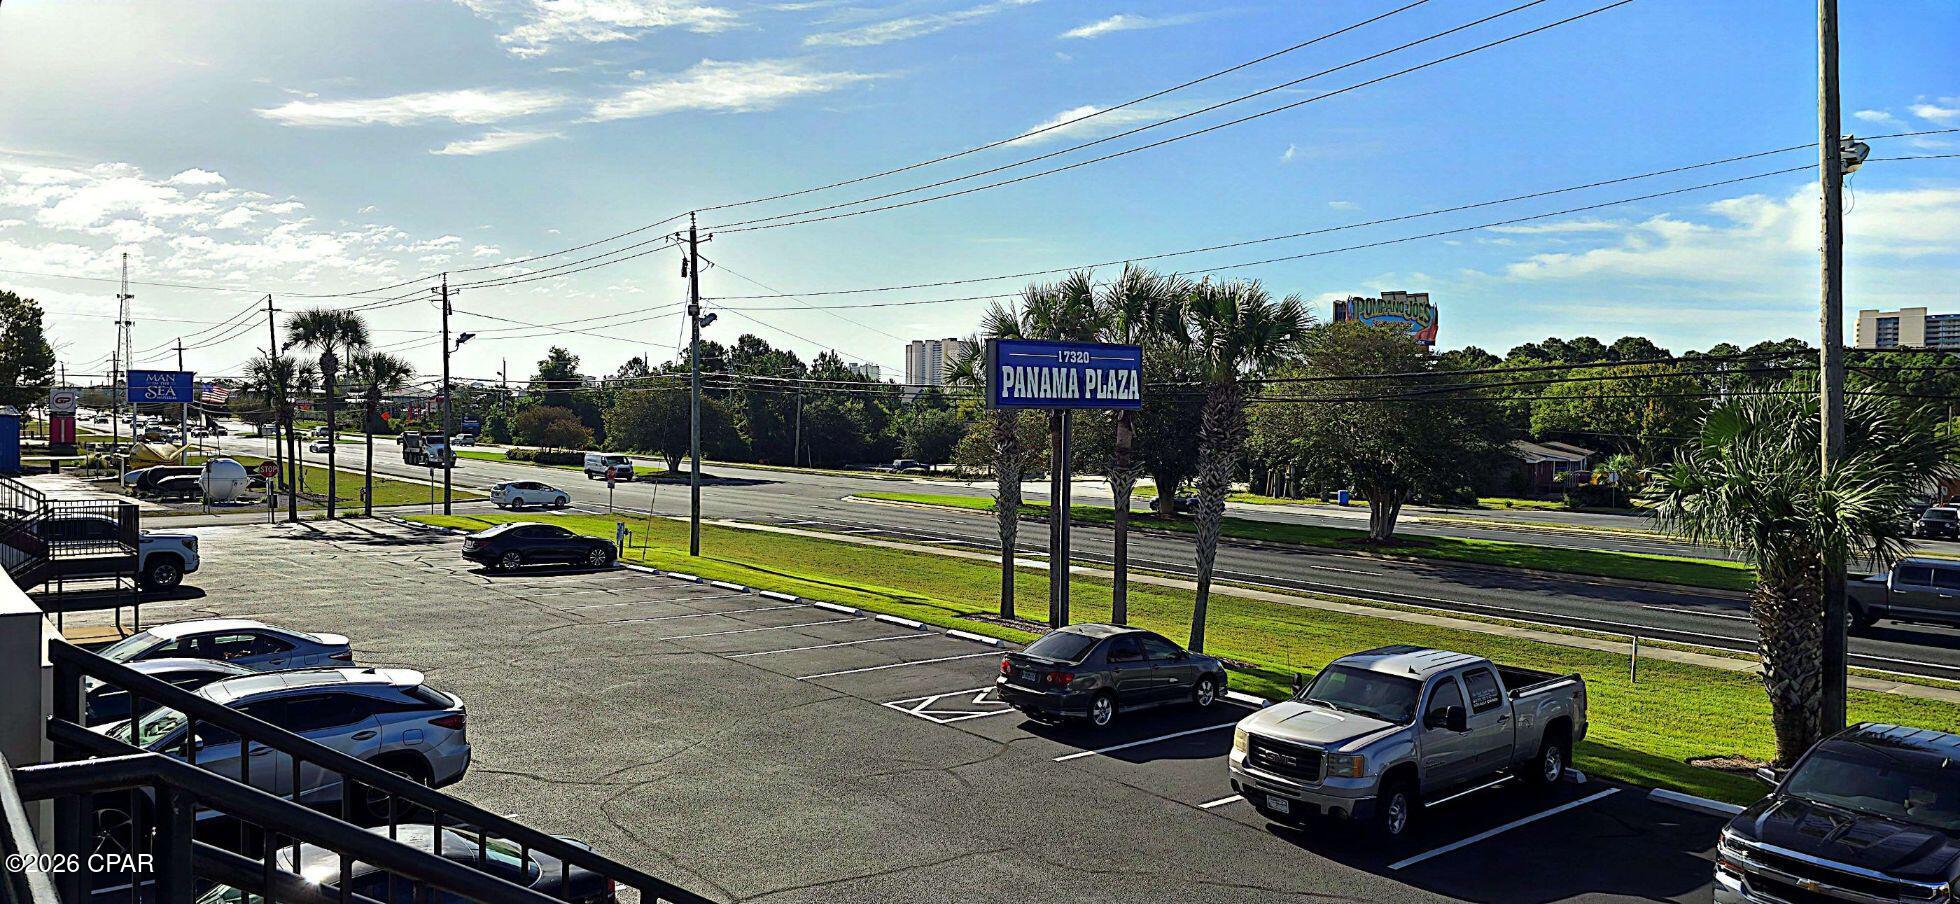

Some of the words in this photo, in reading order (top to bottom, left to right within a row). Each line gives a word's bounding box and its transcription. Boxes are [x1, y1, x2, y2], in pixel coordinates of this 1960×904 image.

[1058, 350, 1090, 364] 17320
[146, 374, 176, 382] MAN
[1002, 365, 1080, 399] PANAMA
[1085, 368, 1140, 400] PLAZA
[145, 385, 176, 399] SEA
[260, 465, 277, 473] STOP
[1264, 749, 1297, 767] GMC
